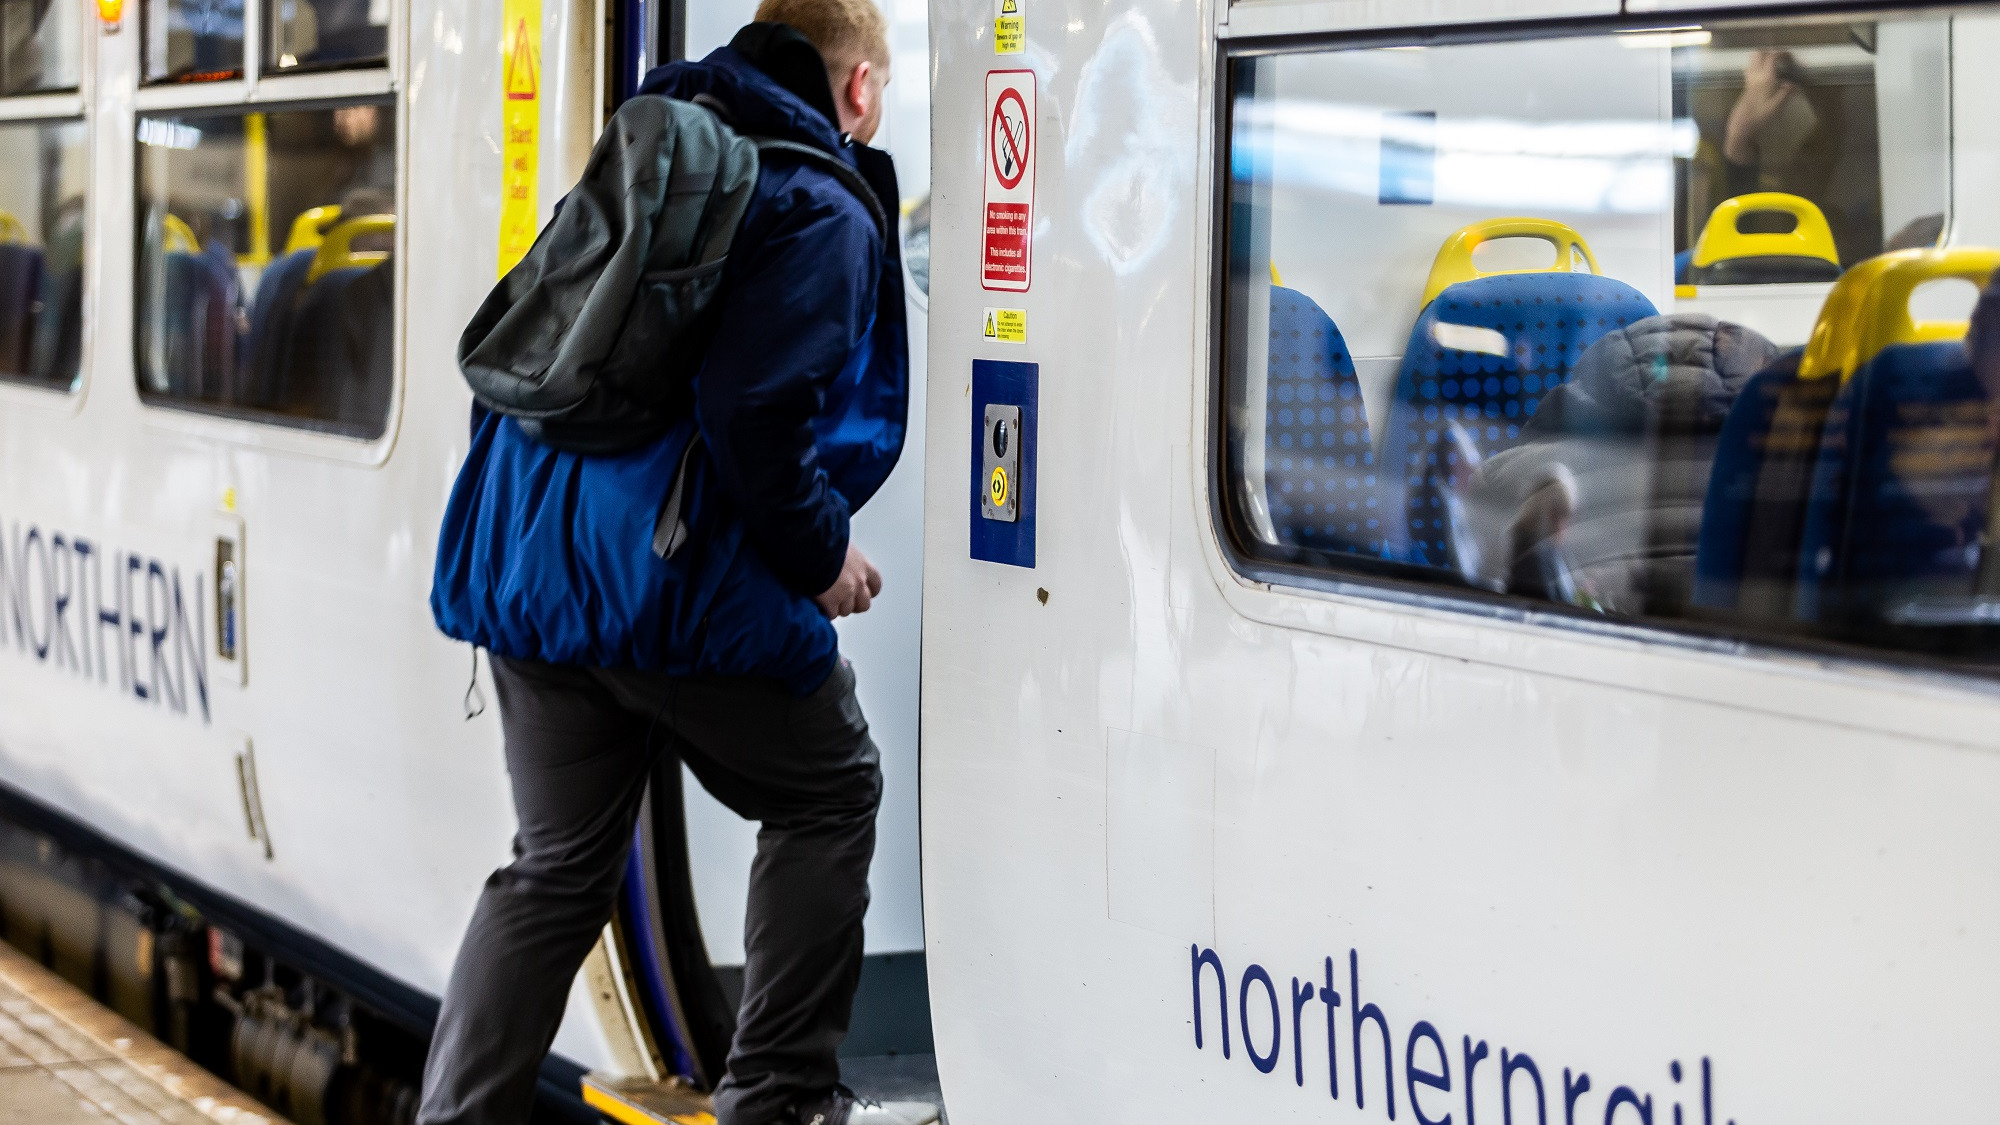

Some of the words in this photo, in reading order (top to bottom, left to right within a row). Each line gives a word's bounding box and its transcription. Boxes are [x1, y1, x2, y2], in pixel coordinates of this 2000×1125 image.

[1000, 20, 1019, 31] Warning
[990, 210, 995, 219] No
[996, 211, 1013, 222] smoking
[996, 225, 1008, 235] within
[1009, 226, 1017, 235] this
[990, 247, 998, 256] This
[999, 248, 1016, 258] includes
[985, 262, 1004, 272] electronic
[1003, 311, 1017, 319] Caution
[0, 513, 212, 726] NORTHERN
[1191, 943, 1736, 1125] northernr
